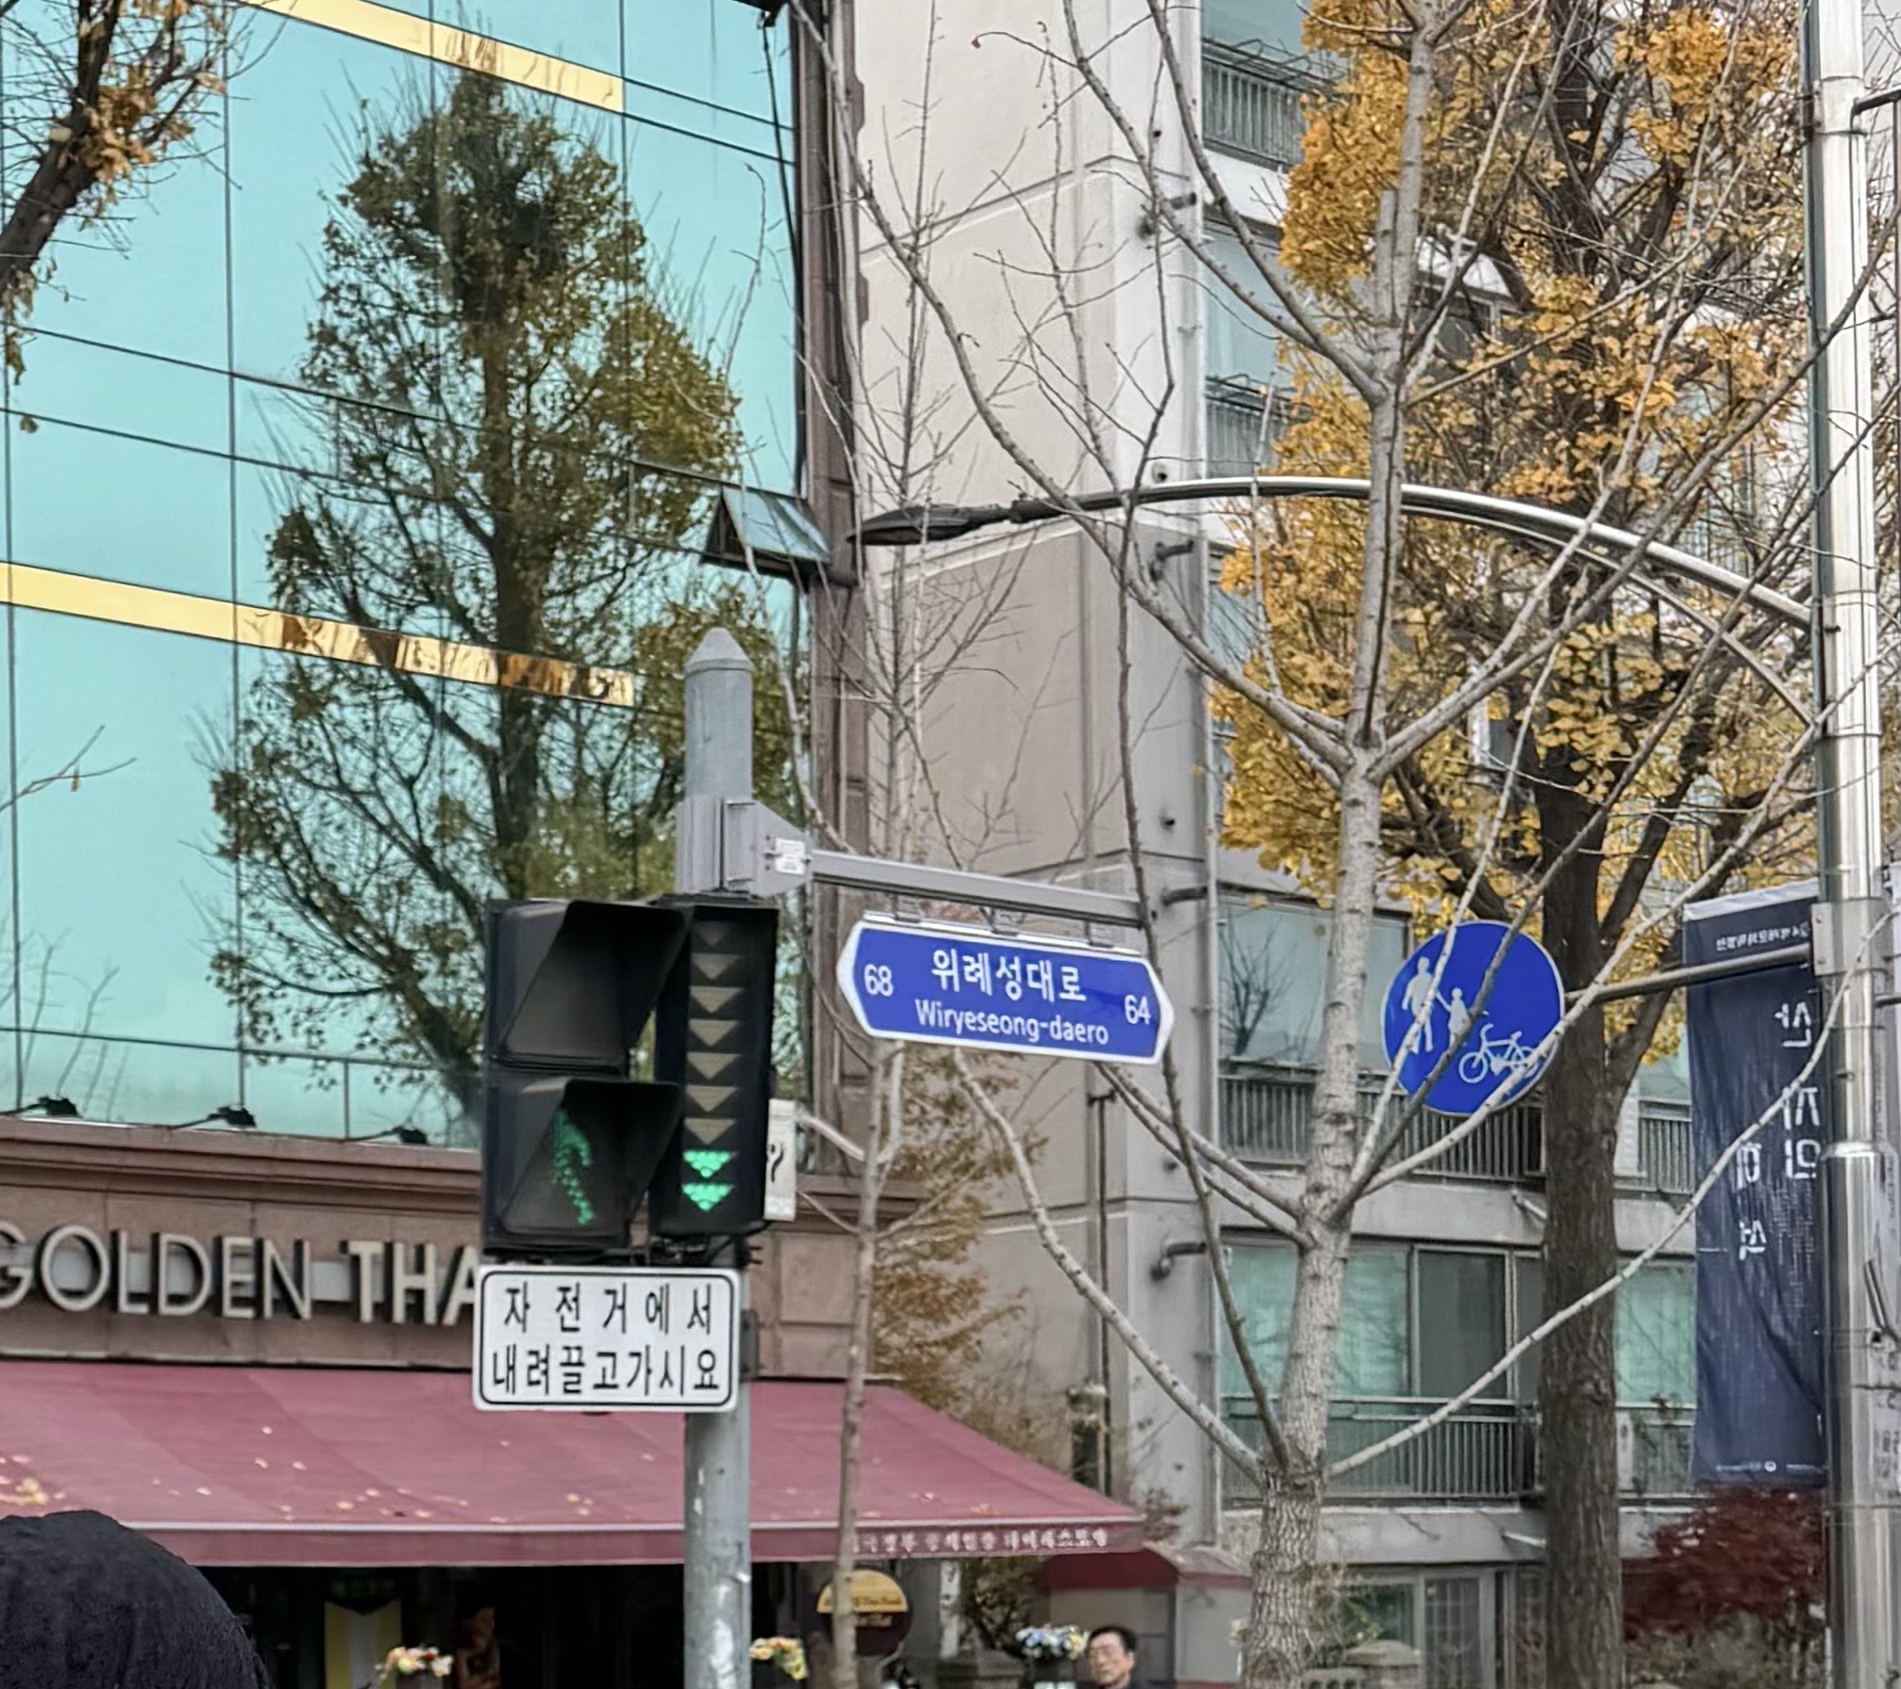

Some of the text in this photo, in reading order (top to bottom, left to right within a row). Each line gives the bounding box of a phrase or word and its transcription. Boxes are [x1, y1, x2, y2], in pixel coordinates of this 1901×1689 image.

[863, 949, 1152, 1025] 68 위례성대로 64
[915, 999, 1109, 1046] Wiryeseong-daero
[503, 1281, 712, 1335] 자전거에서
[492, 1343, 720, 1398] 내려끌고가시요
